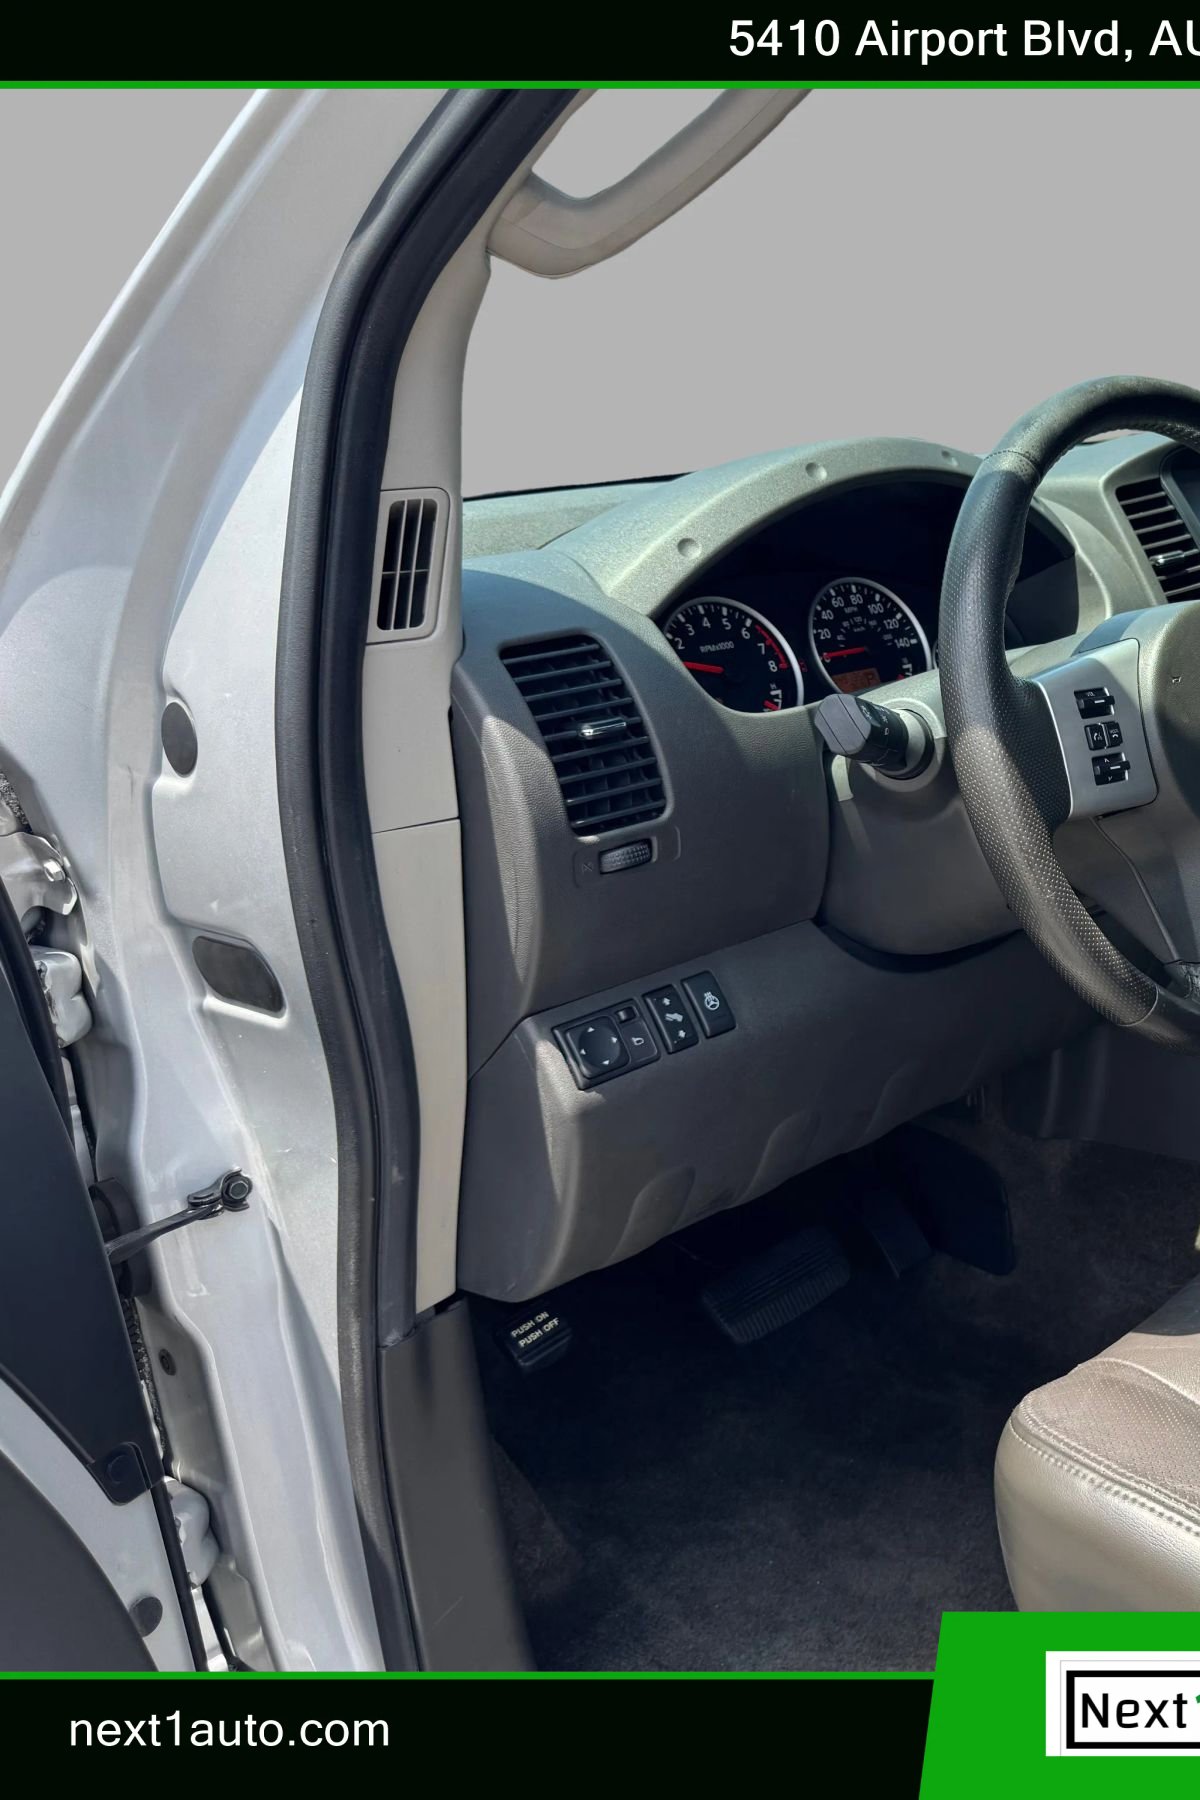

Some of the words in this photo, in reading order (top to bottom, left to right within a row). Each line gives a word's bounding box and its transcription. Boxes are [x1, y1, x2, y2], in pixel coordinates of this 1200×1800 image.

[831, 596, 844, 608] 60
[849, 593, 863, 605] 80
[821, 609, 834, 620] 40
[868, 603, 884, 615] 100
[702, 616, 711, 629] 4
[722, 618, 732, 630] 5
[883, 618, 899, 630] 120
[685, 623, 695, 636] 3
[741, 627, 751, 640] 6
[818, 628, 832, 640] 20
[674, 637, 685, 650] 2
[757, 642, 766, 655] 7
[894, 637, 911, 649] 140
[767, 659, 778, 673] 8
[511, 1320, 536, 1338] PUSH
[535, 1311, 550, 1322] ON
[519, 1329, 544, 1348] PUSH
[543, 1317, 559, 1332] OFF
